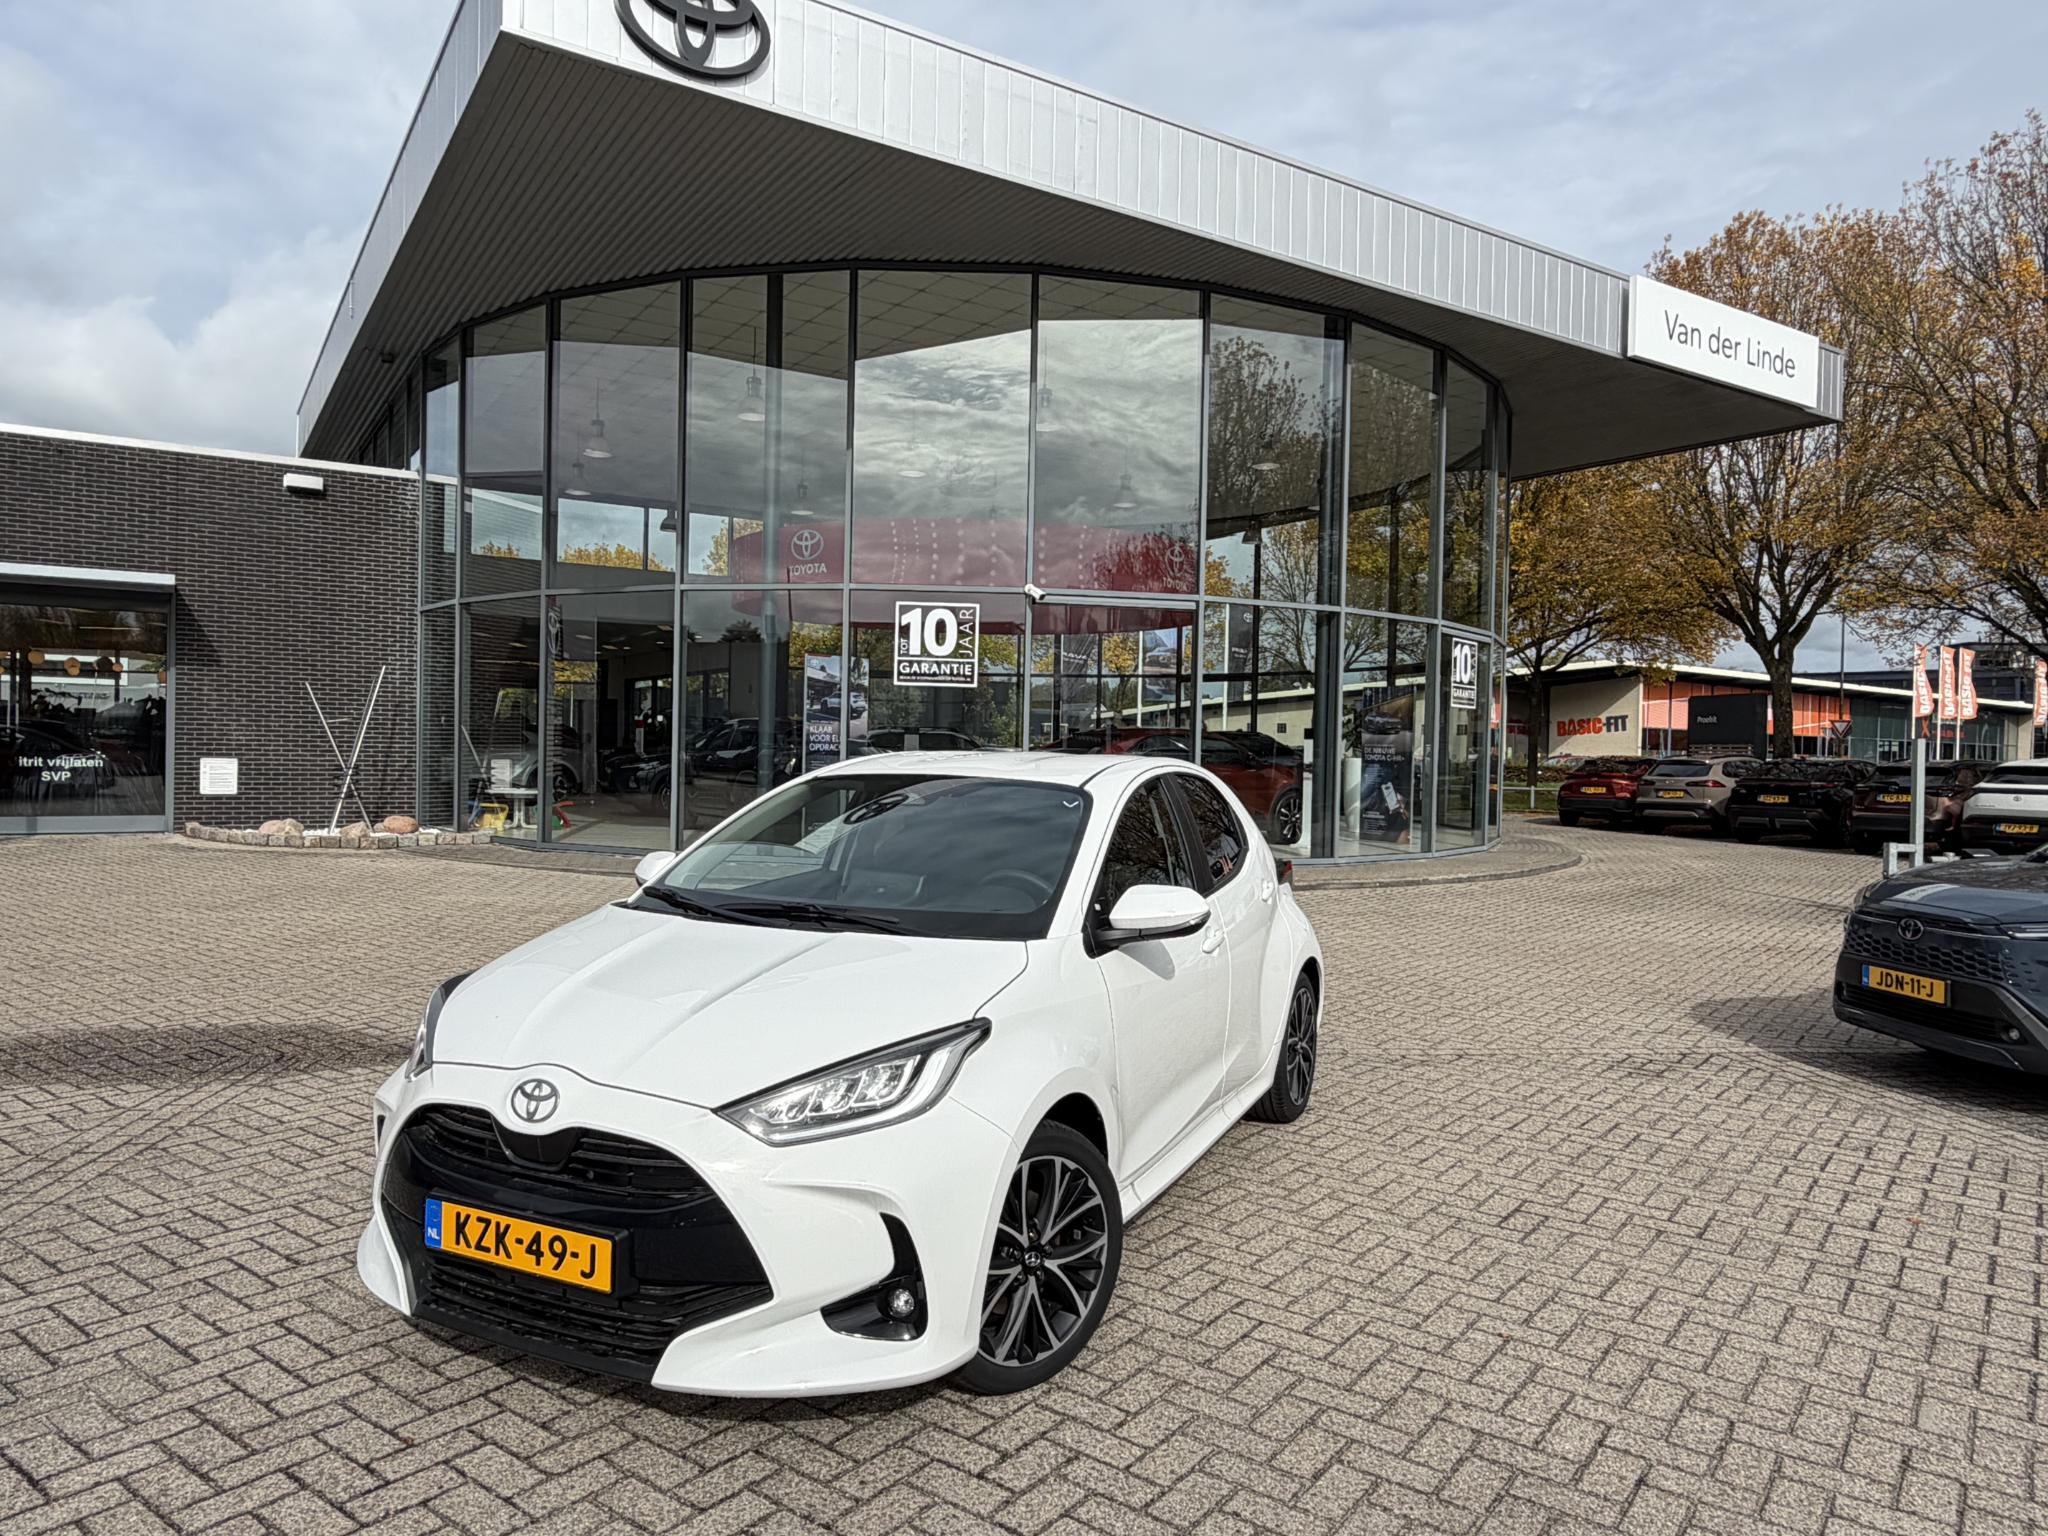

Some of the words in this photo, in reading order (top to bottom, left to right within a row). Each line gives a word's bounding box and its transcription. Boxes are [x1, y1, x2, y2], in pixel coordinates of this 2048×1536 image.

[1664, 309, 1702, 349] Van
[1708, 326, 1741, 360] der
[1747, 337, 1796, 378] Linde
[788, 562, 828, 576] TOYOTA
[901, 607, 958, 657] 10
[959, 609, 974, 657] JAAR
[900, 637, 908, 655] TOT
[899, 662, 973, 675] GARANTIE
[1454, 643, 1471, 684] 10
[809, 725, 833, 734] KLAAR
[1556, 714, 1629, 736] BASIC-FIT
[809, 734, 830, 743] VOOR
[47, 756, 103, 769] vrijlaten
[41, 770, 71, 782] SVP
[1876, 970, 1934, 998] JDN-11-J
[427, 1226, 440, 1239] NL
[455, 1211, 597, 1279] KZK-49-J
